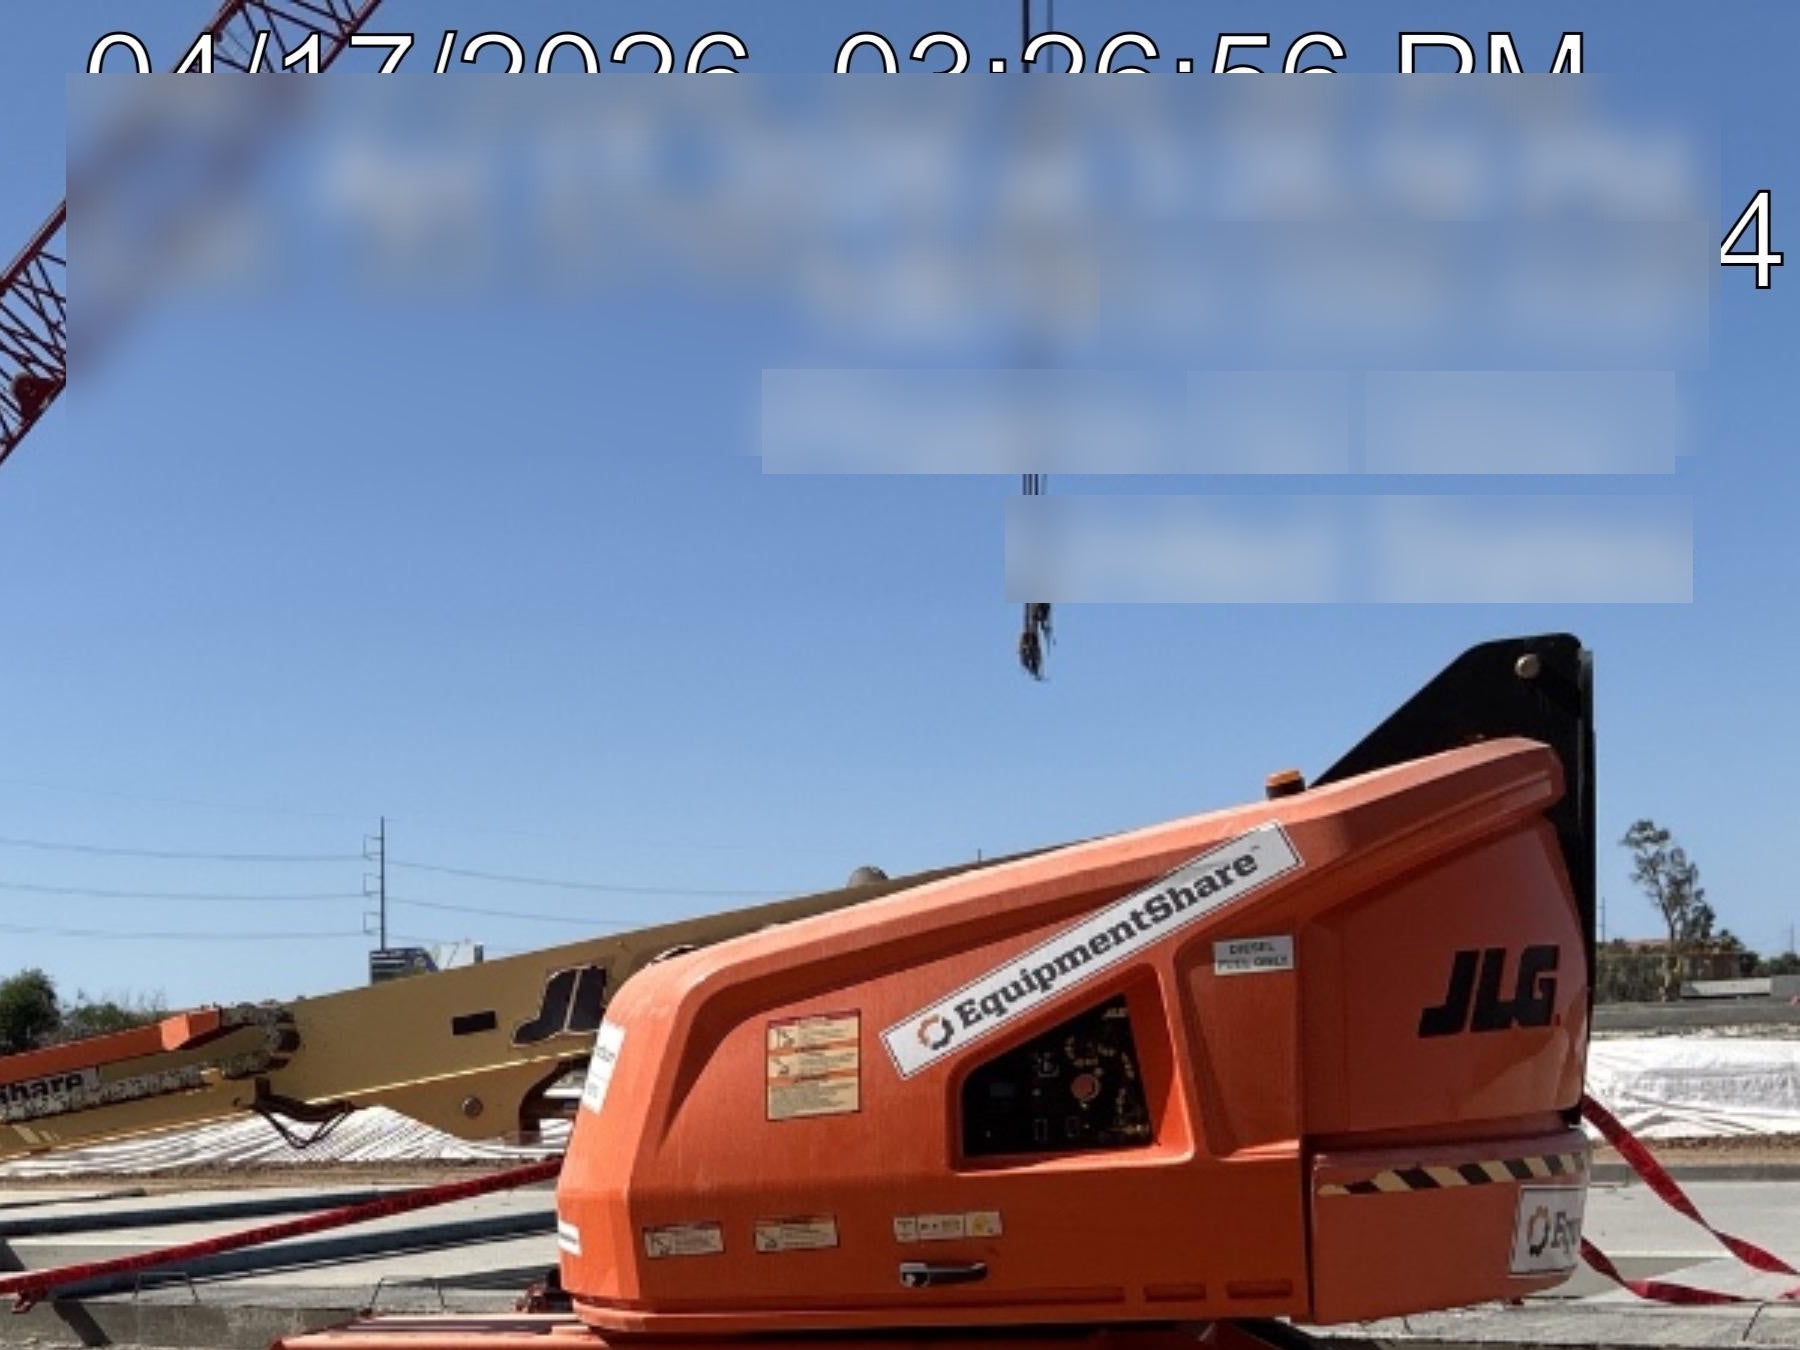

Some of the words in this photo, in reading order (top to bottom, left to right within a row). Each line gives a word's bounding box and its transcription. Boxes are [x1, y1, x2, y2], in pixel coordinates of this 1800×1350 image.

[953, 853, 1258, 1030] EquipmentShare
[511, 964, 607, 1047] JL
[1417, 944, 1561, 1039] JLG
